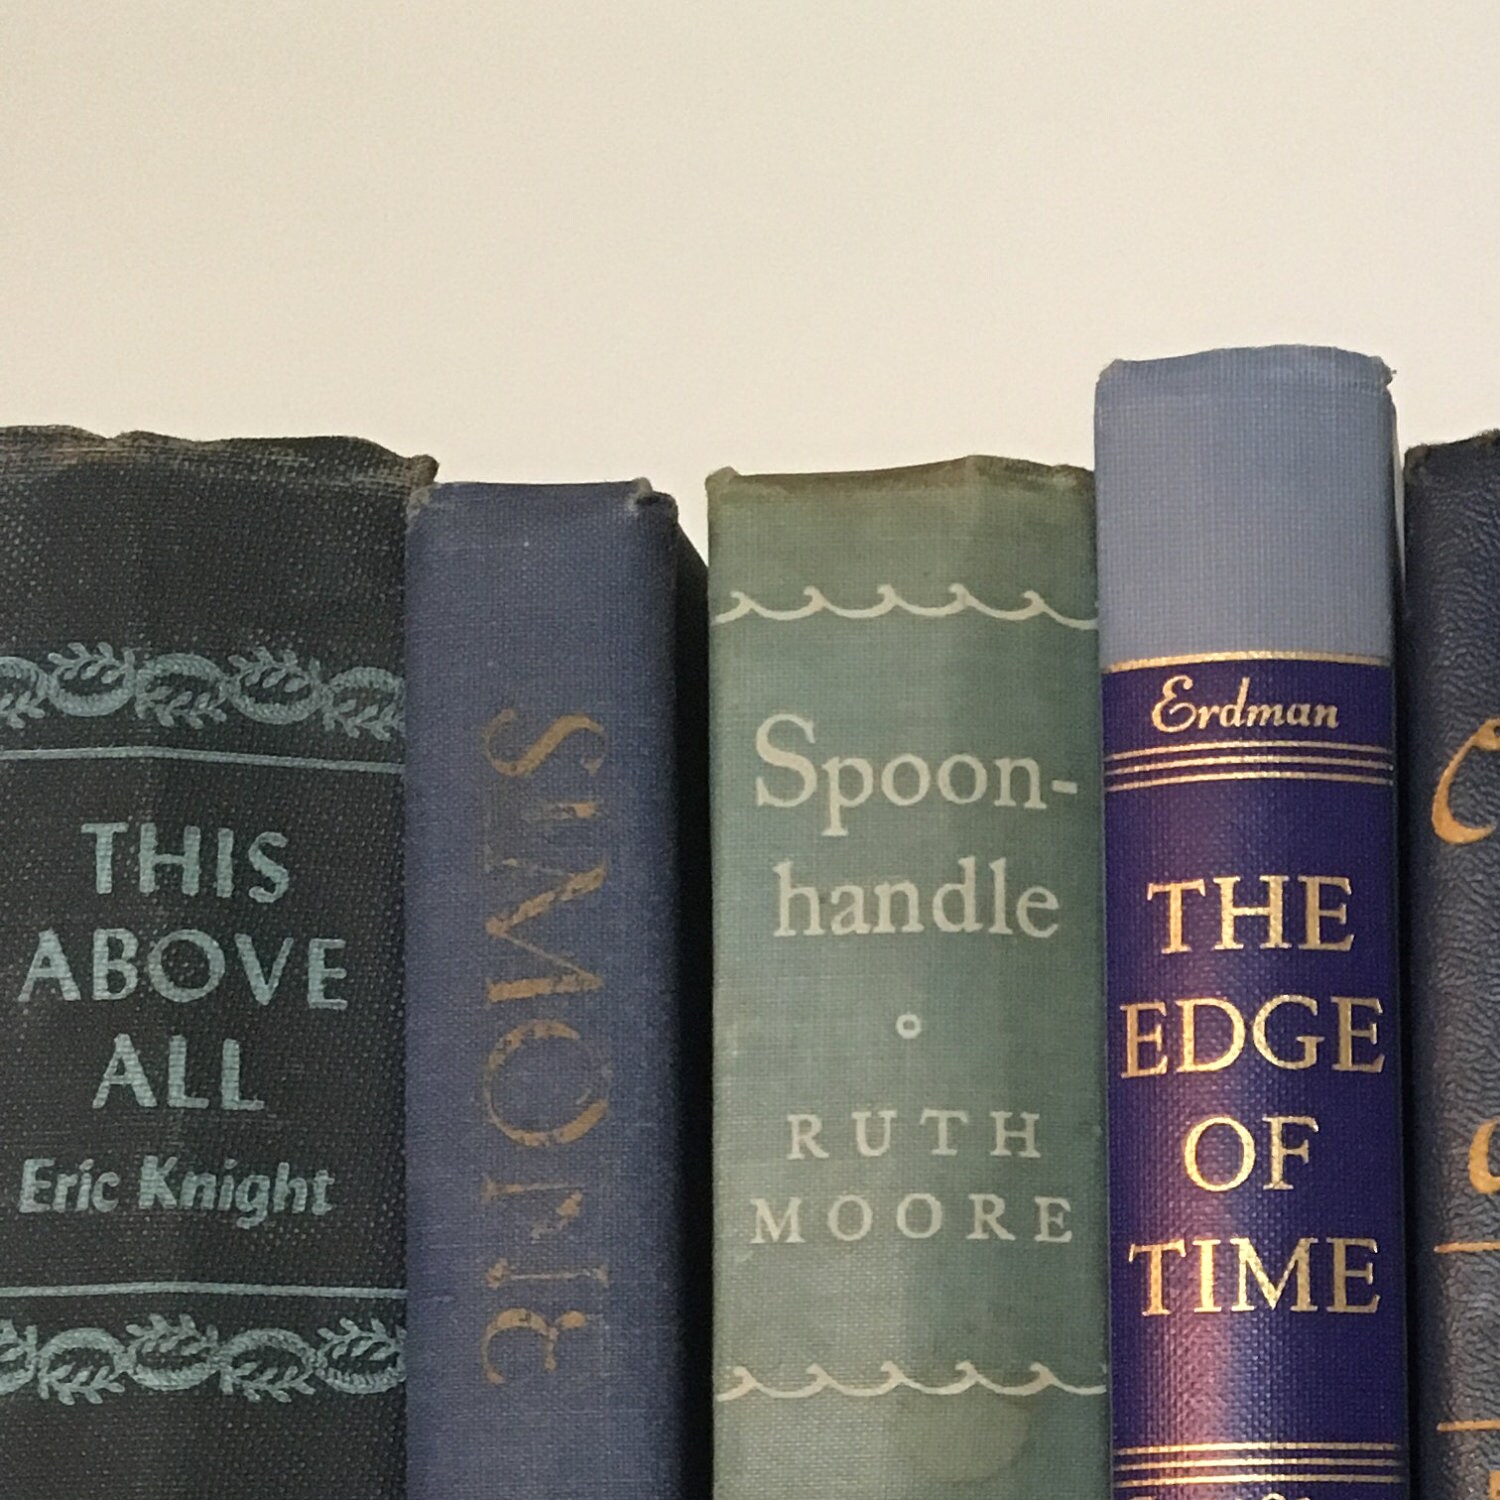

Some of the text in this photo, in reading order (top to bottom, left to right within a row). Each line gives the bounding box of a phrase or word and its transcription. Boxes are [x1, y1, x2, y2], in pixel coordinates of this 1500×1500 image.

[1149, 674, 1341, 732] Erdman
[753, 712, 1080, 837] Spoon-
[80, 820, 292, 905] THIS
[772, 857, 1061, 940] handle
[1146, 874, 1356, 956] THE
[17, 927, 349, 1010] ABOVE
[91, 1032, 266, 1113] ALL
[482, 706, 611, 1387] SIMONE
[1118, 993, 1387, 1080] EDGE
[785, 1109, 1042, 1161] RUTH
[1182, 1114, 1321, 1194] OF
[17, 1154, 336, 1231] Eric Knight
[750, 1191, 1074, 1246] MOORE
[1127, 1235, 1383, 1318] TIME
